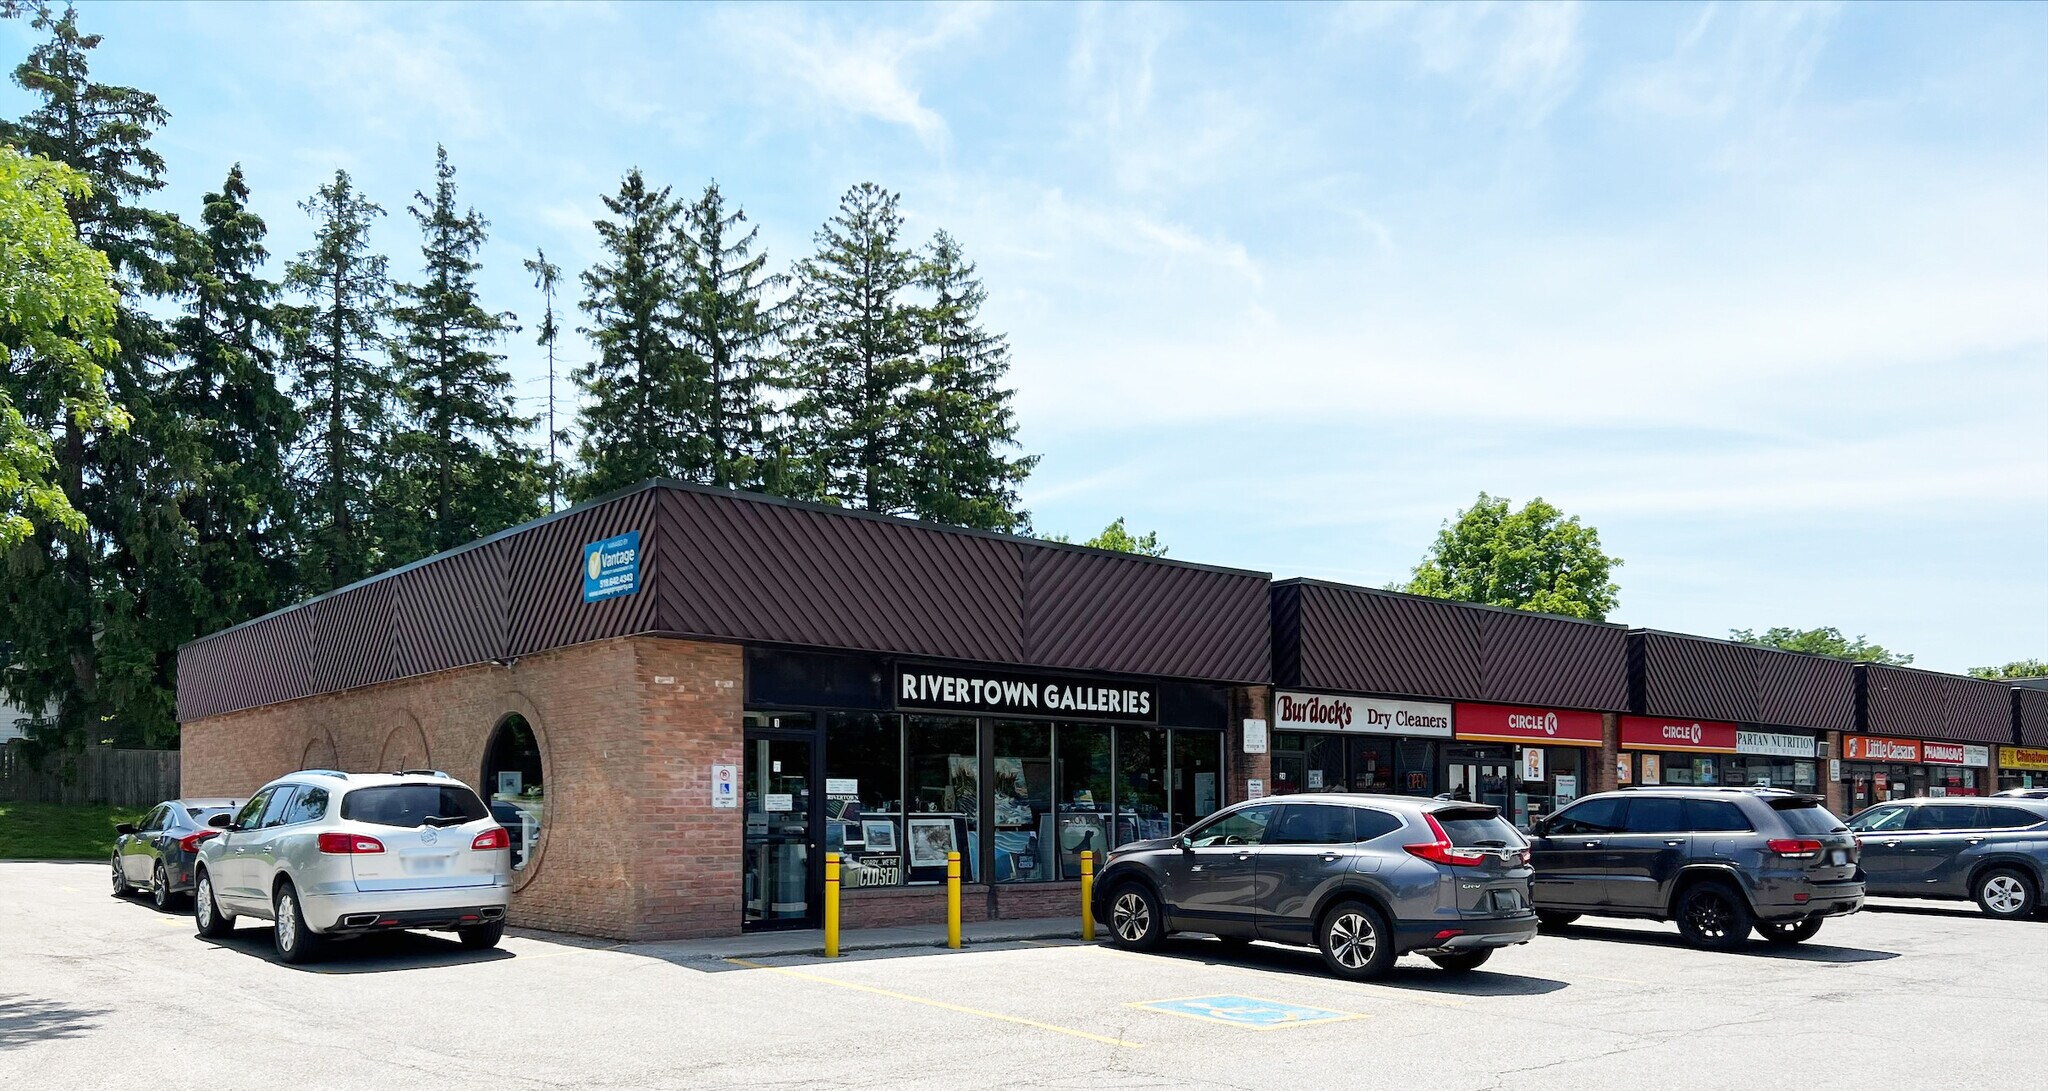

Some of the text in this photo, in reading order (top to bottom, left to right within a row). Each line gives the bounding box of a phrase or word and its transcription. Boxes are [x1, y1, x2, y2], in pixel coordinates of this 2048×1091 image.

[602, 549, 635, 568] Vantage
[902, 673, 1150, 714] RIVERTOWN GALLERIES
[1277, 695, 1447, 729] Burdock's Dry Cleaners
[1508, 712, 1558, 735] CIRCLE K
[1662, 723, 1702, 744] CIRCLE K
[1737, 732, 1814, 749] PARTAN NUTRITION
[1865, 739, 1916, 760] Little Caesars
[1924, 745, 1963, 761] PHARMASAVE
[1409, 773, 1427, 789] OPEN
[860, 867, 899, 887] CLOSED
